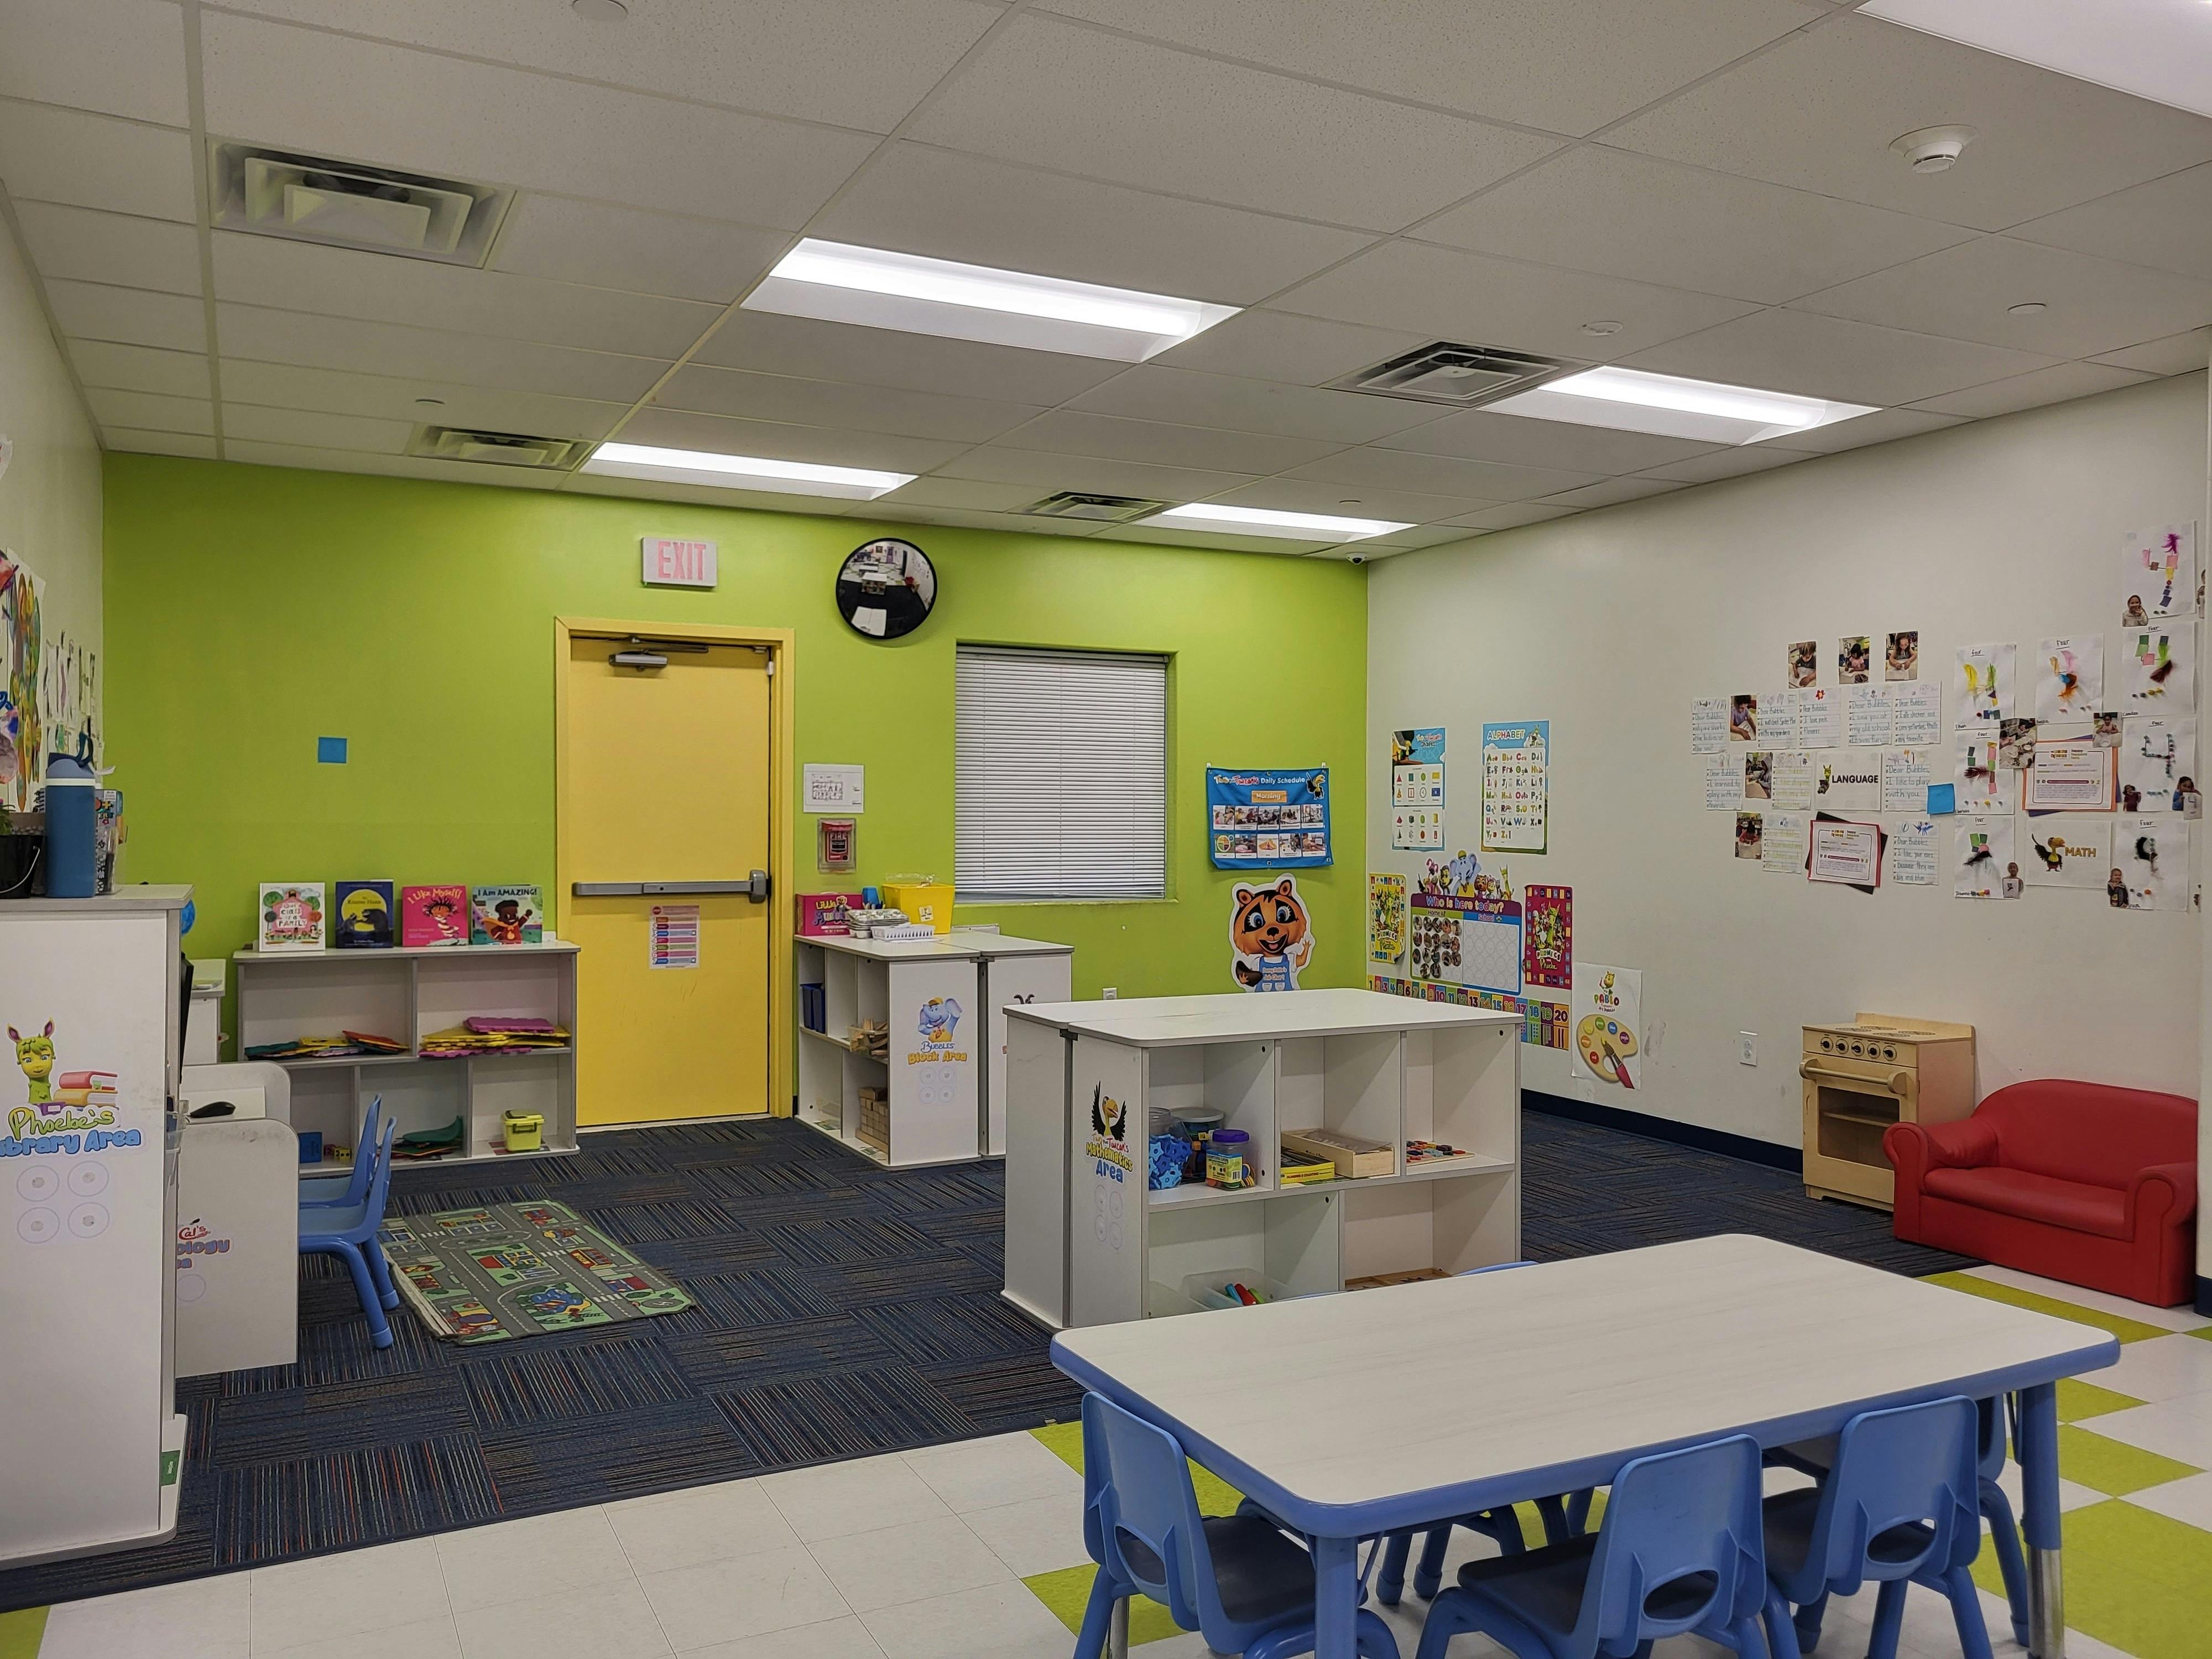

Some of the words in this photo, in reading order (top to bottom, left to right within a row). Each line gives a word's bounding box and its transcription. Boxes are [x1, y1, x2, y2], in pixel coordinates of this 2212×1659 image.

[658, 541, 706, 581] EXIT
[1871, 722, 1890, 731] school
[1488, 730, 1525, 740] ALPHABET
[1906, 765, 1930, 774] Bubbles
[1832, 775, 1879, 784] LANGUAGE
[1916, 777, 1929, 786] play
[1709, 791, 1719, 800] play
[2065, 847, 2096, 857] MATH
[413, 889, 431, 900] Like
[1426, 895, 1444, 907] Who
[1446, 896, 1453, 908] is
[1454, 898, 1473, 910] here
[1474, 900, 1504, 914] today?
[1376, 929, 1399, 942] PHONICS
[1536, 948, 1562, 962] PHONICS
[1540, 958, 1558, 971] Phoebe
[1369, 980, 1373, 990] 1
[1375, 980, 1381, 991] 2
[1383, 982, 1389, 993] 3
[1390, 983, 1396, 993] 4
[1397, 984, 1404, 995] 5
[1405, 985, 1411, 996] 6
[1413, 987, 1419, 998] 7
[1421, 988, 1426, 999] 8
[1428, 989, 1434, 1001] 9
[1435, 990, 1446, 1002] 10
[1448, 992, 1455, 1003] 11
[1457, 993, 1468, 1005] 12
[1469, 995, 1479, 1007] 13
[1480, 997, 1491, 1009] 14
[1493, 999, 1503, 1011] 15
[1504, 1000, 1515, 1013] 16
[1516, 1003, 1527, 1015] 17
[1528, 1005, 1540, 1018] 18
[1541, 1006, 1553, 1021] 19
[1554, 1009, 1569, 1022] 20
[1594, 994, 1620, 1006] PABLO
[907, 1052, 939, 1065] Block
[942, 1050, 968, 1062] Area
[8, 1107, 115, 1141] Phoebe's
[84, 1129, 142, 1152] Area
[1106, 1138, 1129, 1153] Toucan's
[1086, 1141, 1134, 1172] Mathematics
[1095, 1159, 1124, 1183] Area
[178, 1225, 207, 1240] Cal's
